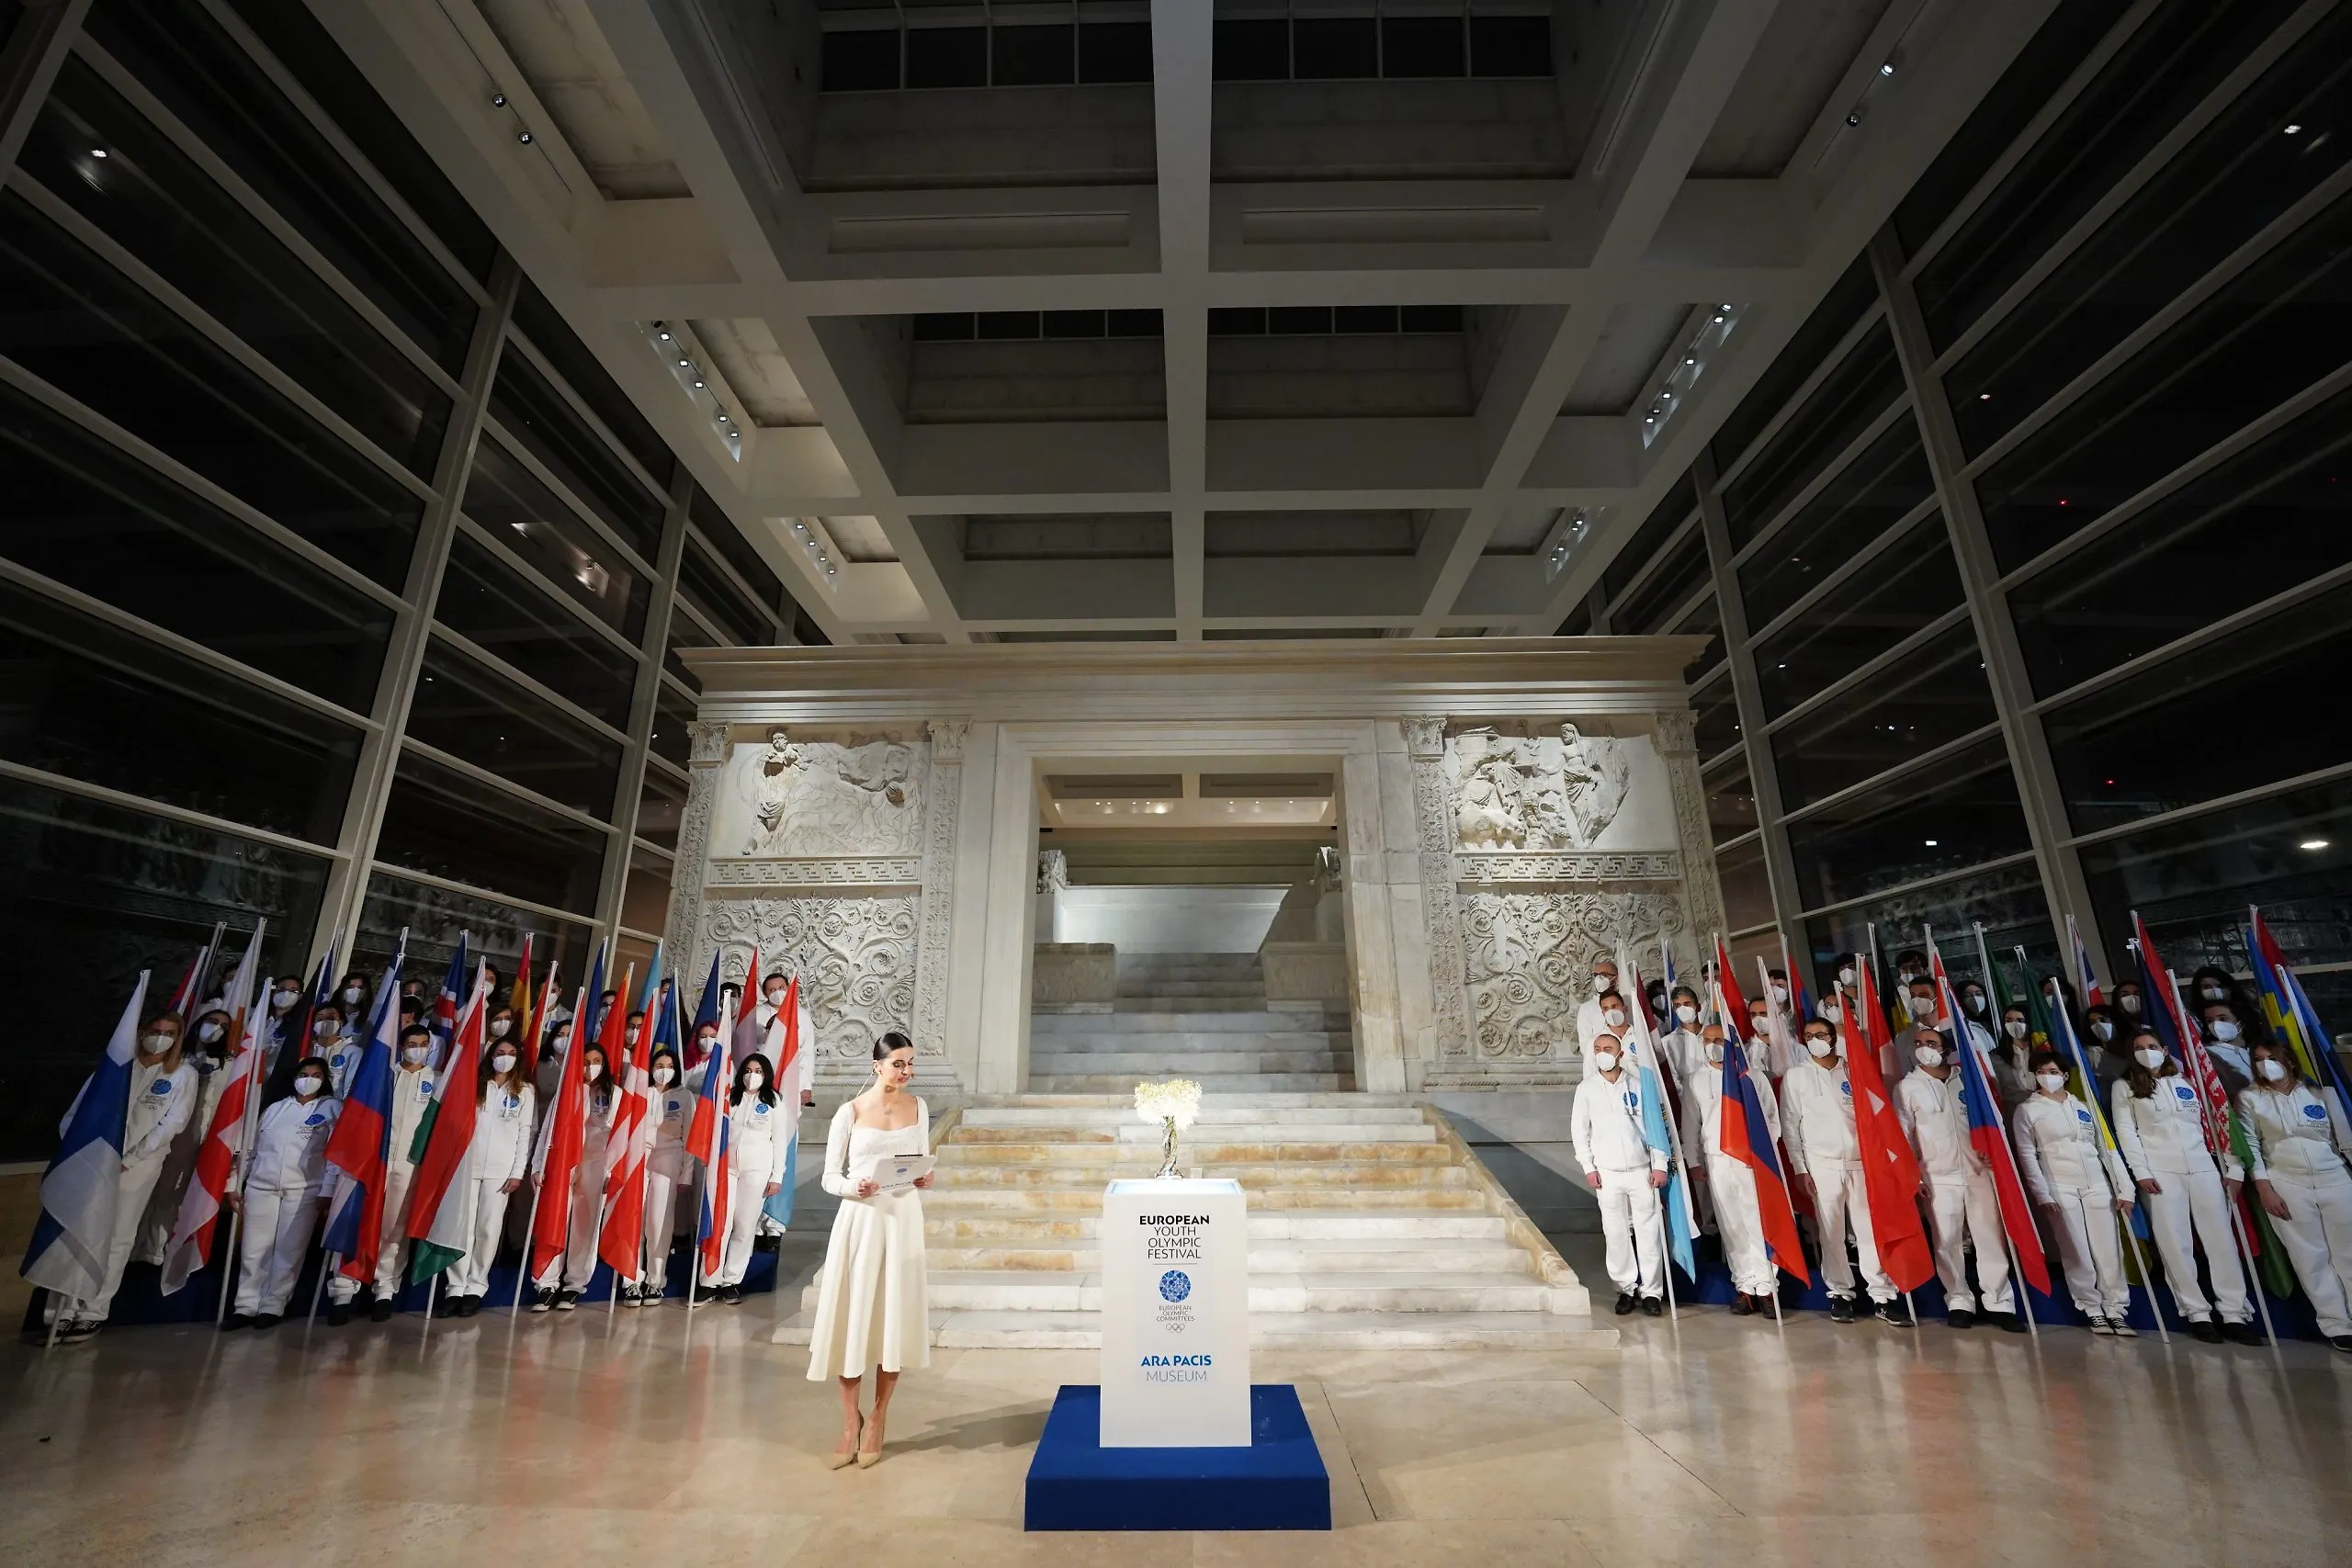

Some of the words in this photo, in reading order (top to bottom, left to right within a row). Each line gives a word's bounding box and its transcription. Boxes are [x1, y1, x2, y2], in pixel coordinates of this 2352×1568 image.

[1139, 1215, 1209, 1224] EUROPEAN
[1154, 1225, 1196, 1236] YOUTH
[1148, 1236, 1202, 1248] OLYMPIC
[1148, 1248, 1202, 1259] FESTIVAL
[1141, 1355, 1170, 1367] ARA
[1173, 1355, 1212, 1366] PACIS
[1147, 1371, 1206, 1382] MUSEUM
